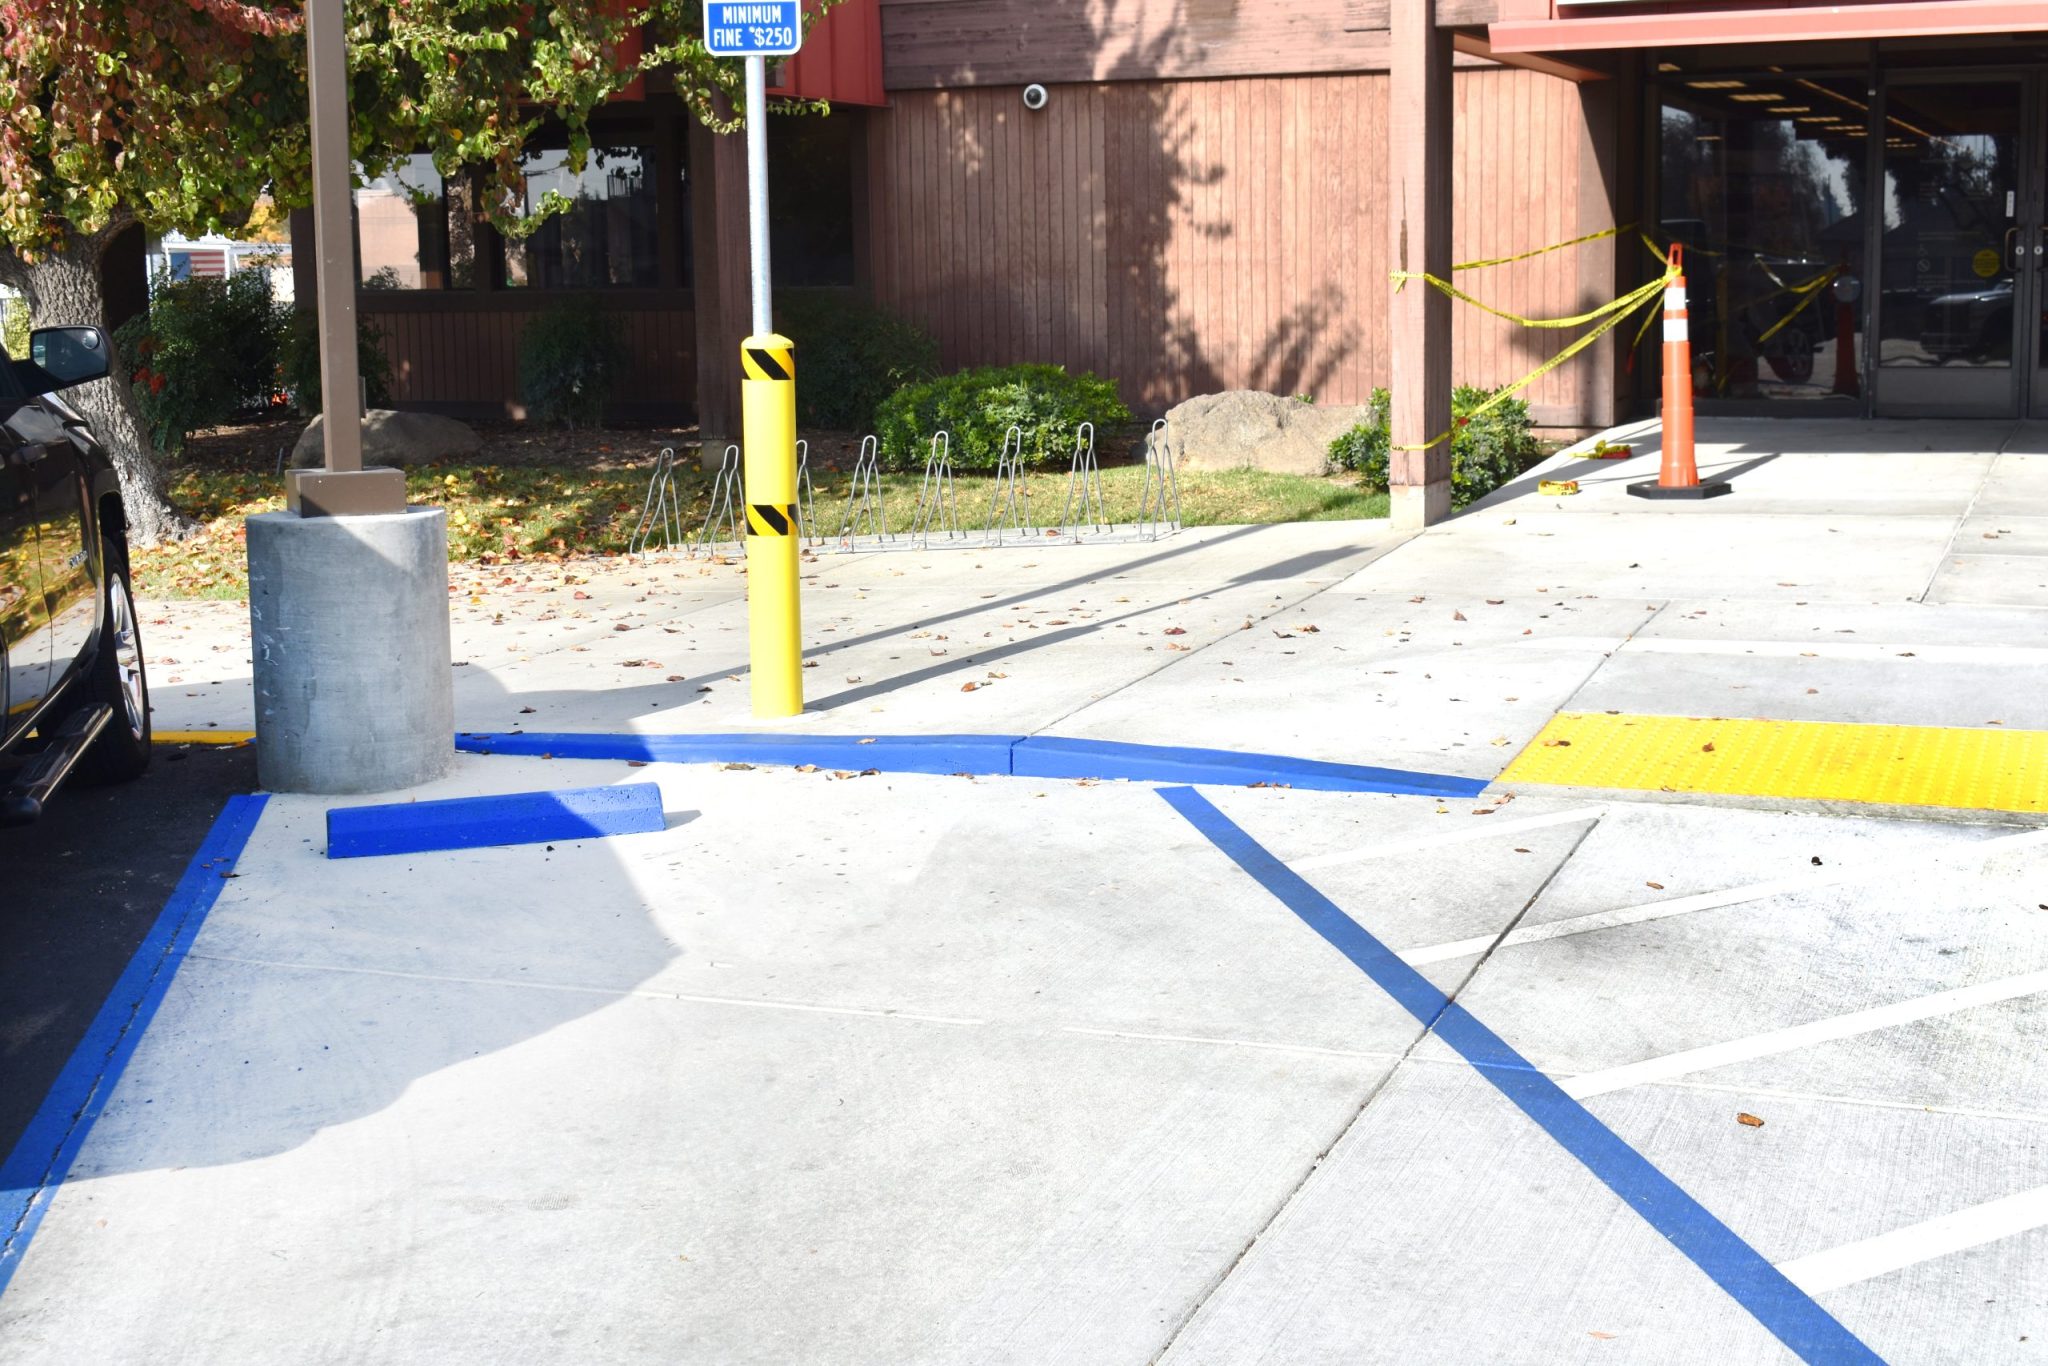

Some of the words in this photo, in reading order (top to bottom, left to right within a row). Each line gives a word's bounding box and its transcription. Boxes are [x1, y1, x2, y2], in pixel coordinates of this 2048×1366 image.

[723, 5, 782, 24] MINIMUM
[714, 28, 743, 47] FINE
[754, 26, 792, 47] $250
